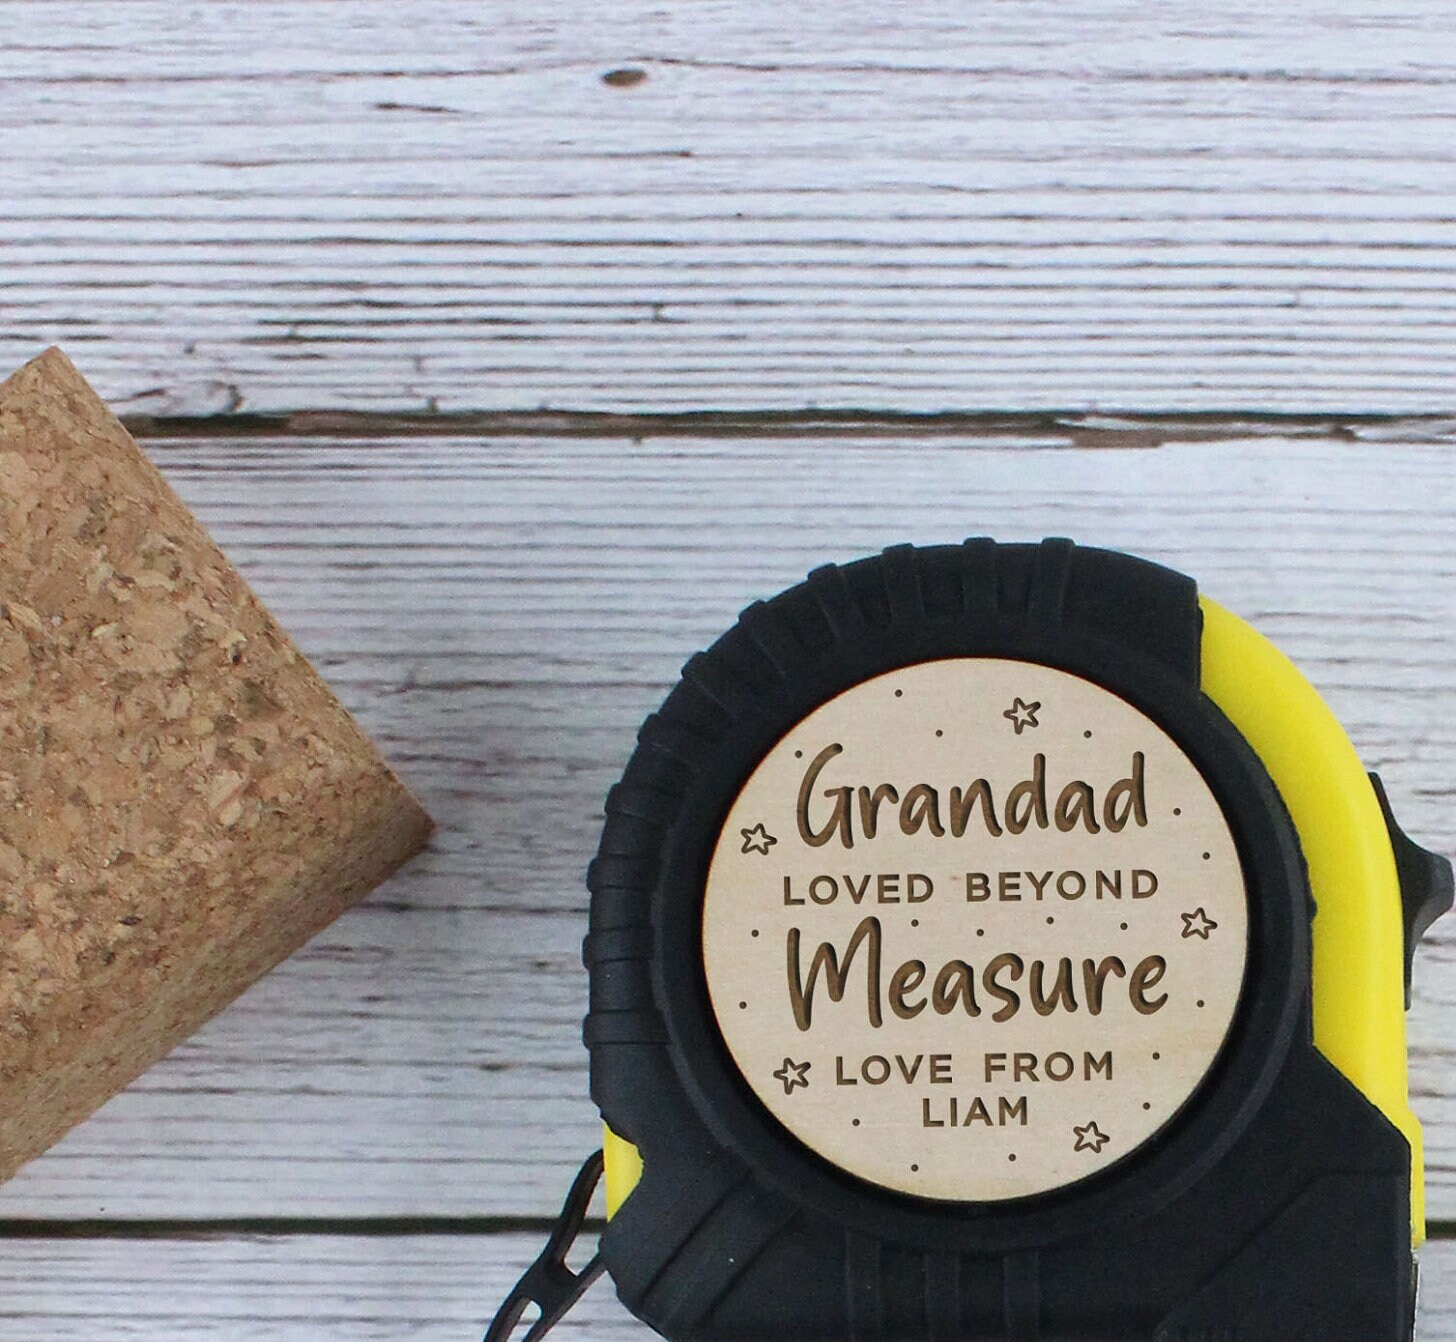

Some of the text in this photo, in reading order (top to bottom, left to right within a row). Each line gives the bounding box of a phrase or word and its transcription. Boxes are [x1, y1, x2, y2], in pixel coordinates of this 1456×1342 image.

[796, 743, 1149, 850] Grandad
[783, 869, 1159, 907] LOVED BEYOND
[787, 915, 1169, 1032] Measure
[835, 1051, 1114, 1086] LOVE FROM
[922, 1096, 1029, 1128] LIAM
